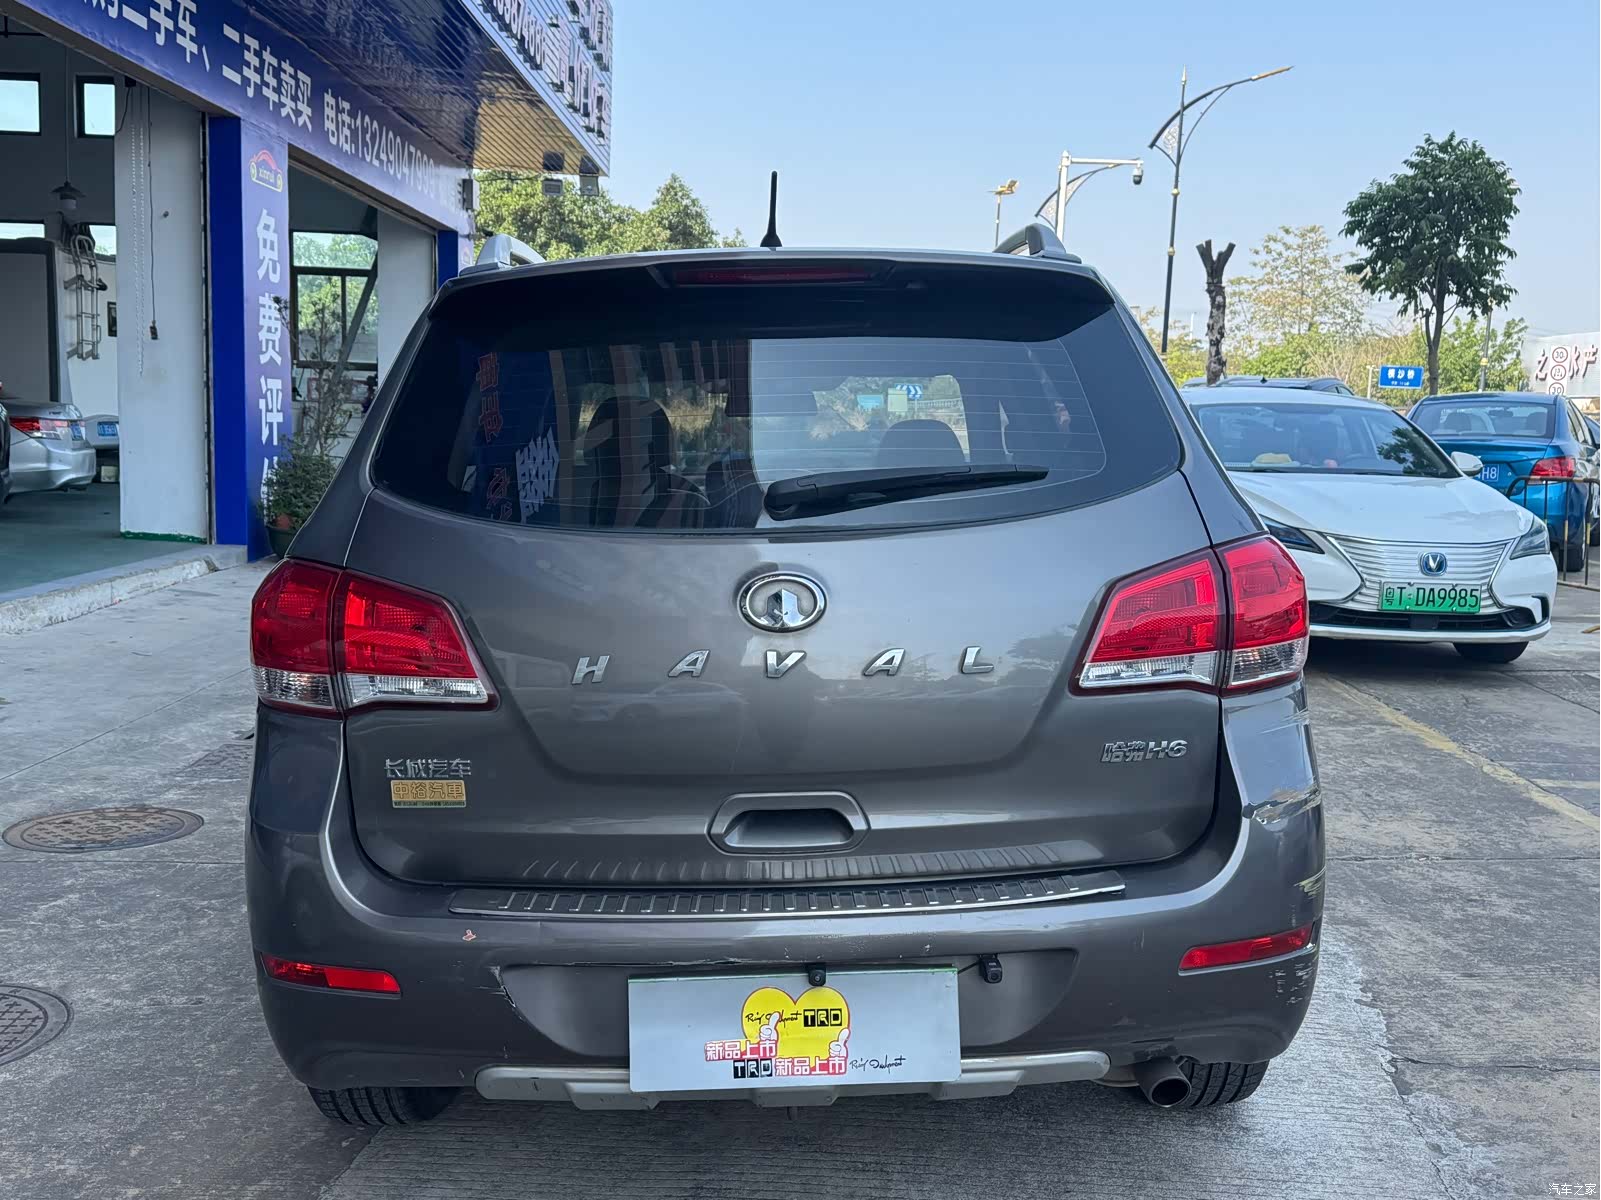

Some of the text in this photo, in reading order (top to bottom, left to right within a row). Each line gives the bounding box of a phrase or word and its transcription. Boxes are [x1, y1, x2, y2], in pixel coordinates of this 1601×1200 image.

[256, 208, 284, 527] 免费评
[571, 645, 994, 685] HAVAL
[384, 758, 472, 778] 长城汽车
[803, 1008, 843, 1027] TRD
[705, 1040, 777, 1060] 新品上市
[733, 1056, 846, 1079] TRD 新品上市
